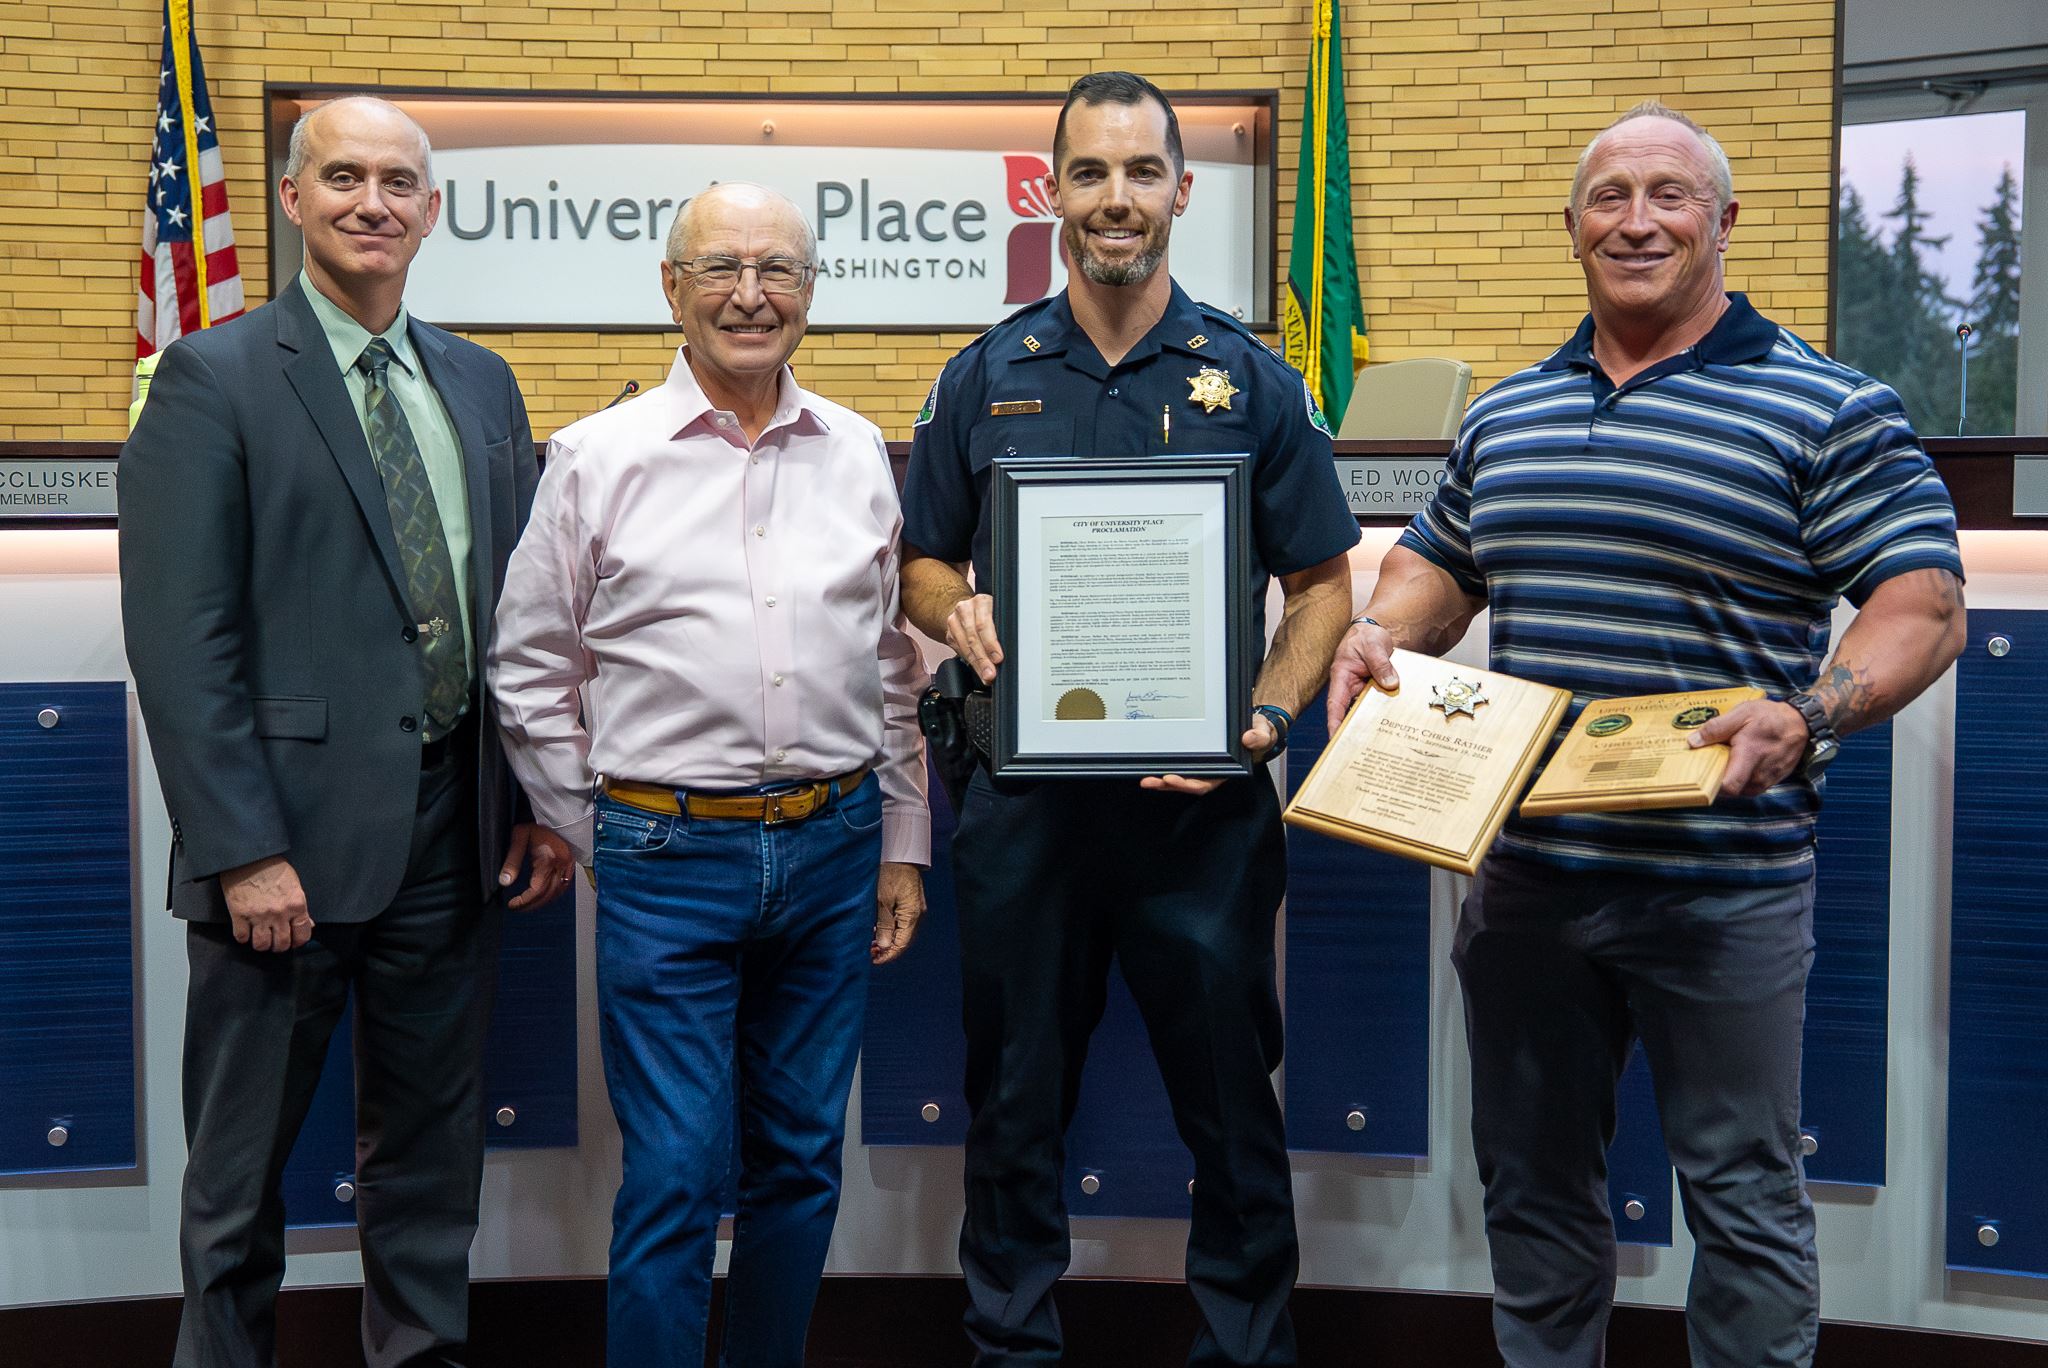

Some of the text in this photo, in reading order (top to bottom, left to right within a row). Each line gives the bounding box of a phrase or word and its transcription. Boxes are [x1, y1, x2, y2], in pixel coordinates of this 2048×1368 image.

[446, 178, 987, 242] Univer Place
[818, 258, 986, 278] ASHINGTON
[1286, 305, 1303, 367] STATE
[0, 471, 118, 488] CLUSKE
[1351, 470, 1446, 486] ED WOO
[0, 493, 69, 505] MEMBER
[1403, 491, 1435, 503] PRO
[1091, 526, 1147, 534] PROCLAMATION
[1100, 519, 1142, 527] UNIVERSITY
[1143, 518, 1165, 526] PLACE
[1380, 718, 1419, 733] DEPUTY
[1421, 729, 1451, 742] CHRIS
